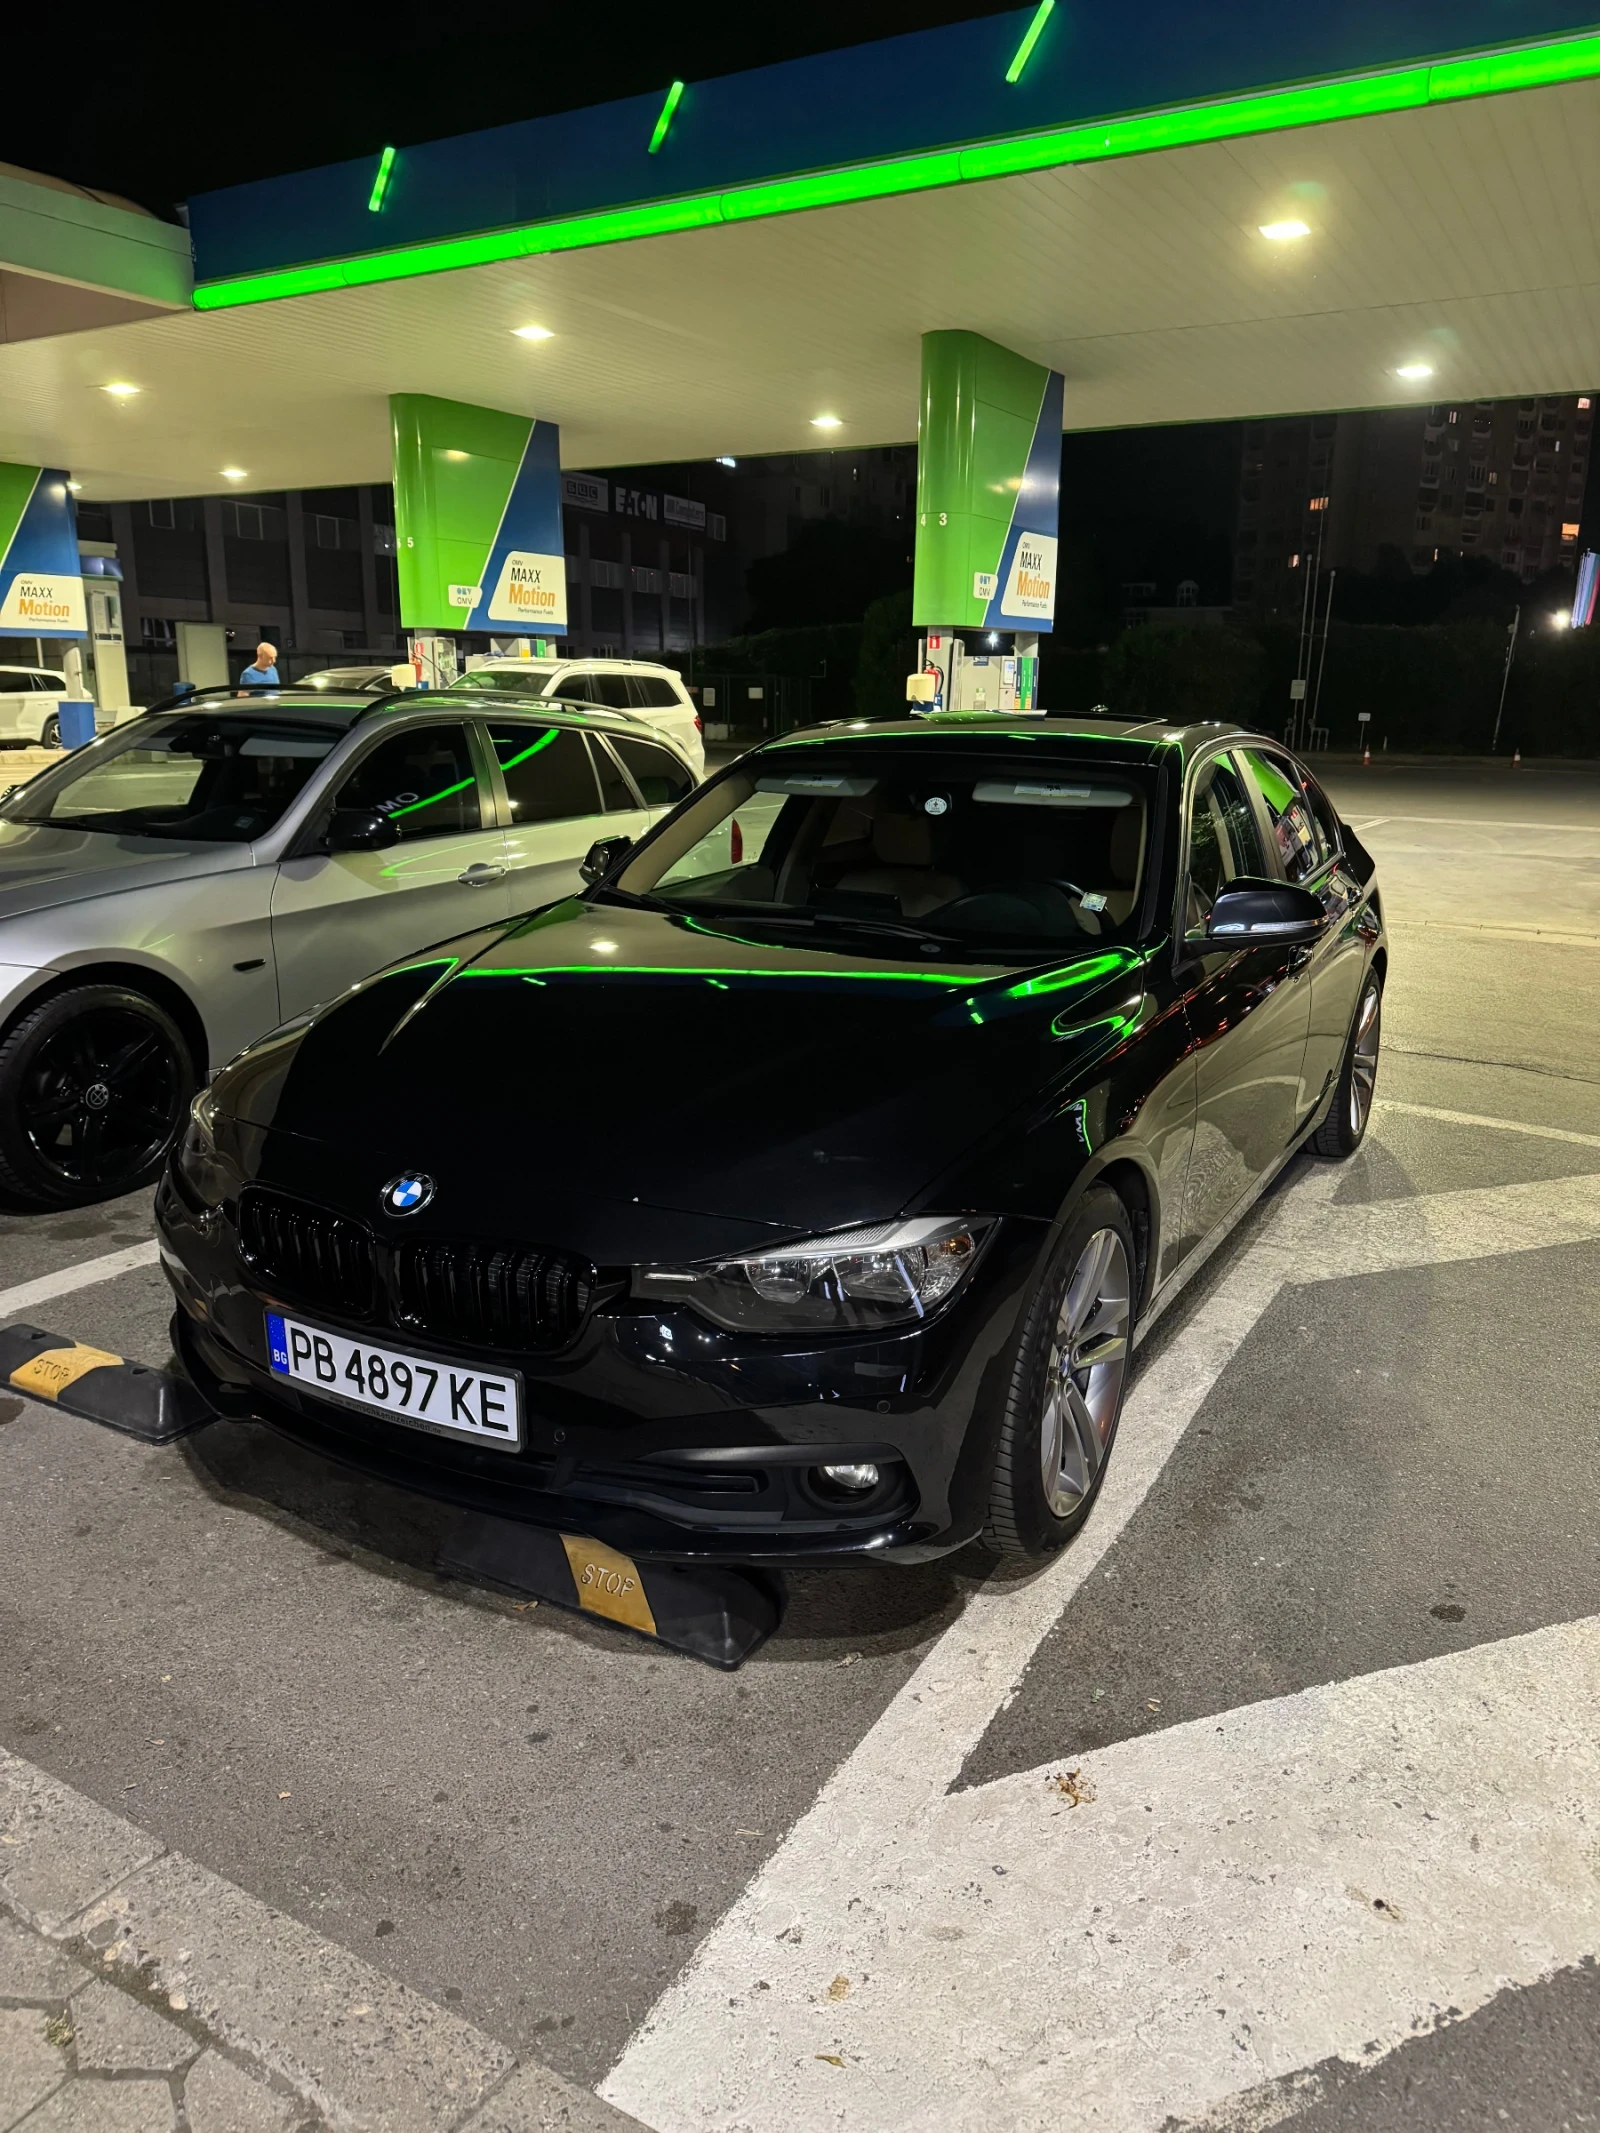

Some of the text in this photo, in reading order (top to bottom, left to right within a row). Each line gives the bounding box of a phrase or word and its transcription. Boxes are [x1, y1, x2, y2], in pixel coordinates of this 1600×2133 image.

[615, 486, 657, 520] EATON
[920, 512, 947, 527] 4 3
[407, 536, 414, 548] 5
[1020, 551, 1043, 571] MAXX
[511, 567, 541, 583] MAXX
[1016, 569, 1050, 599] Motion
[20, 586, 53, 598] MAXX
[457, 597, 472, 605] OMV
[508, 583, 556, 607] Motion
[18, 598, 70, 617] Motion
[518, 607, 542, 615] Performance
[273, 1349, 288, 1365] BG
[33, 1358, 71, 1380] STOP
[290, 1327, 509, 1432] PB 4897 KE
[581, 1563, 635, 1598] STOP
